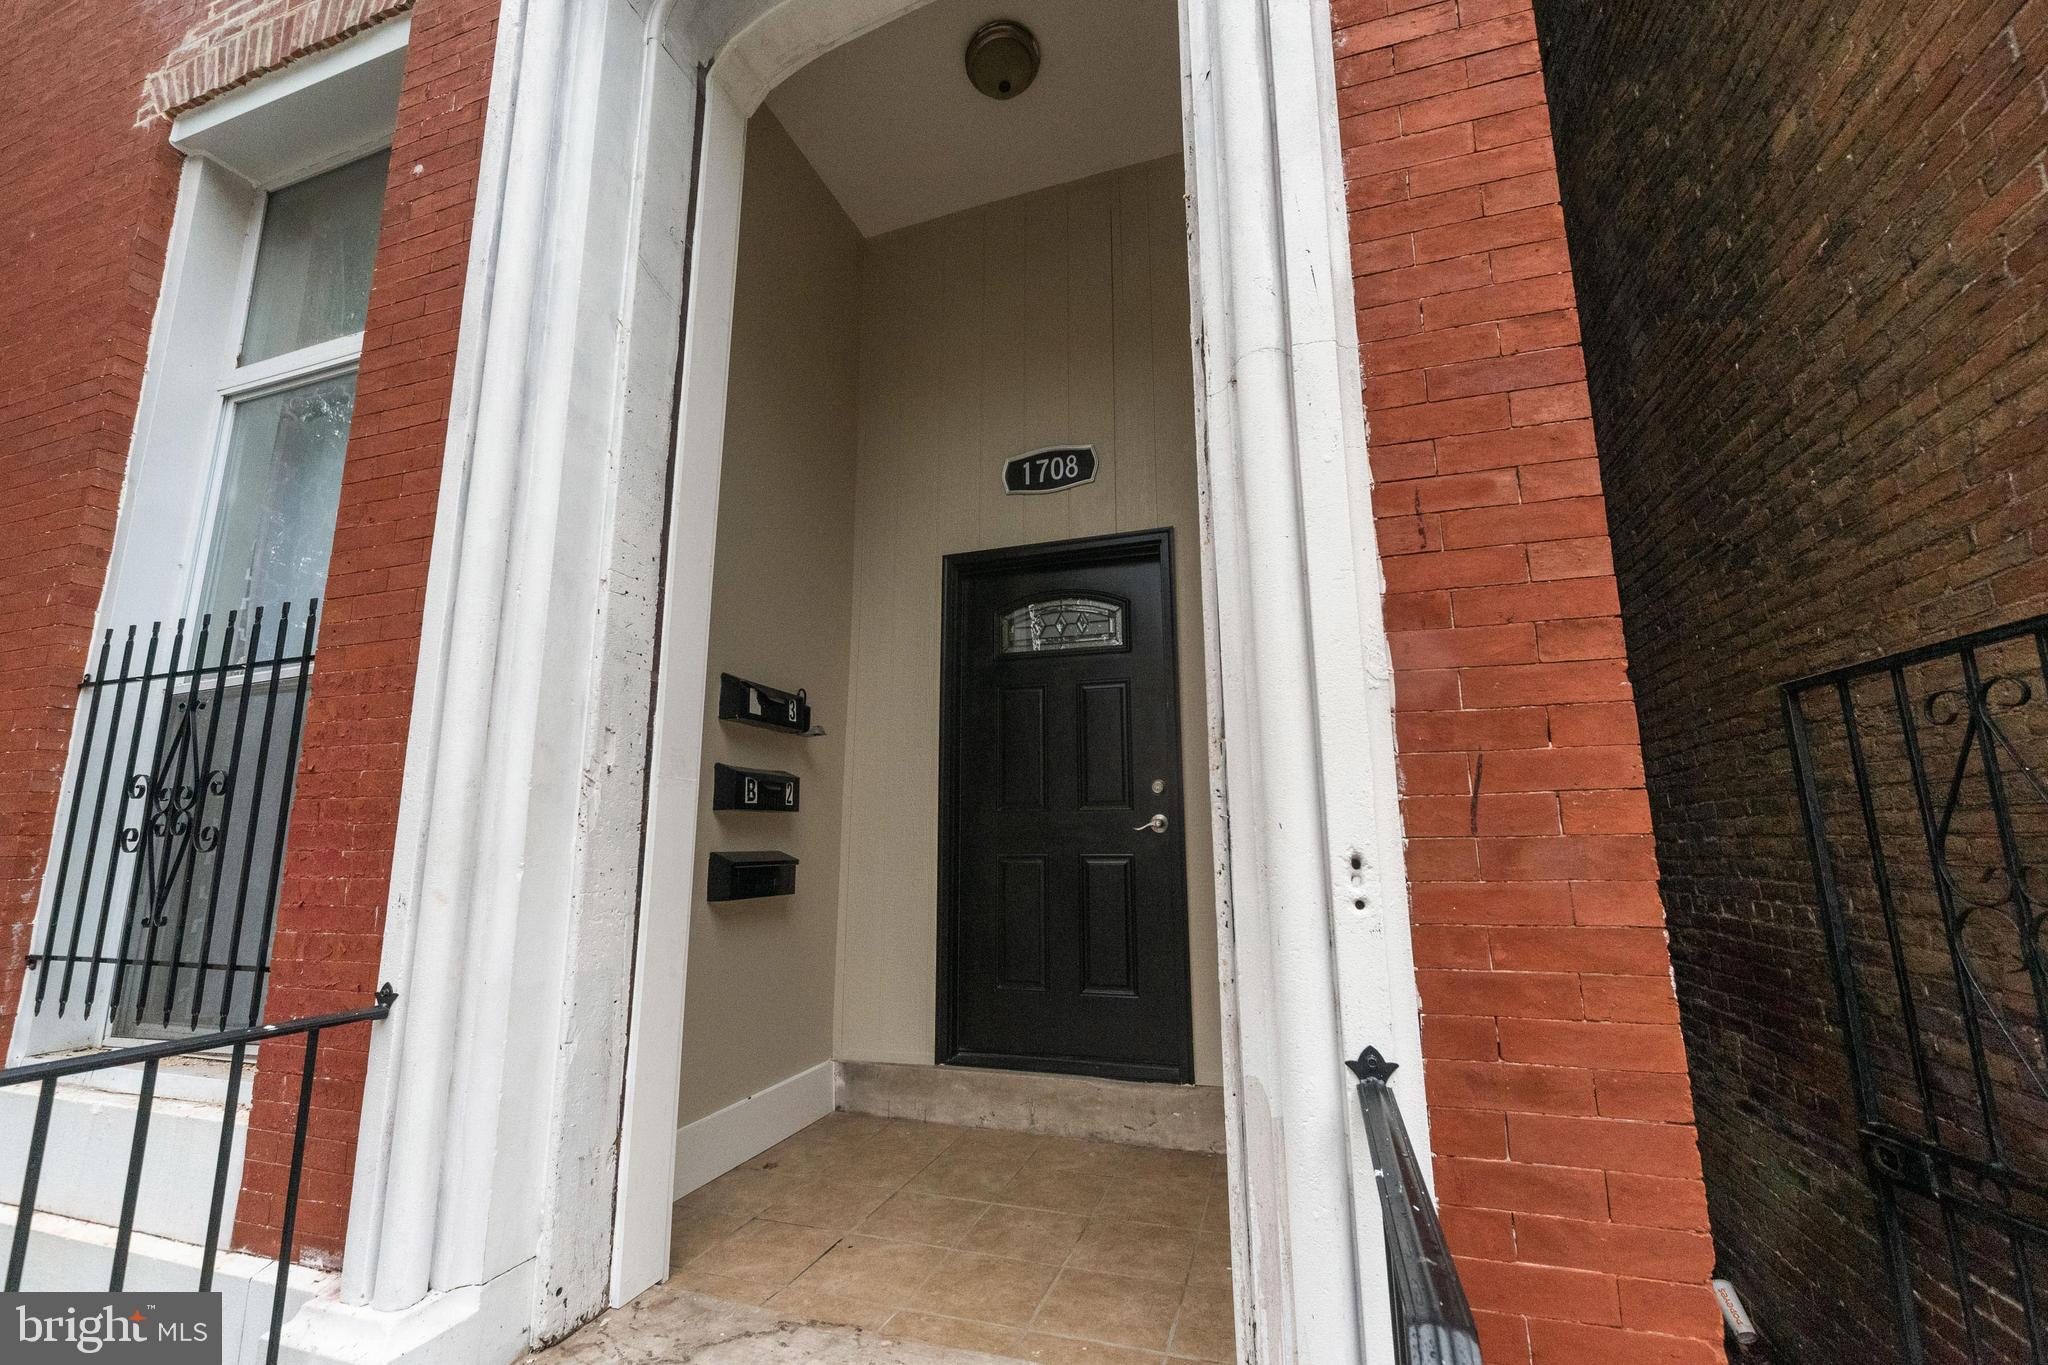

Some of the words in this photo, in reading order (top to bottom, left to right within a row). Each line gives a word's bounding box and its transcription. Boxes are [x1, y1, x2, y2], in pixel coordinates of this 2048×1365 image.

[1023, 454, 1079, 485] 1708
[789, 700, 797, 721] 3
[746, 777, 758, 803] B
[786, 783, 794, 805] 2
